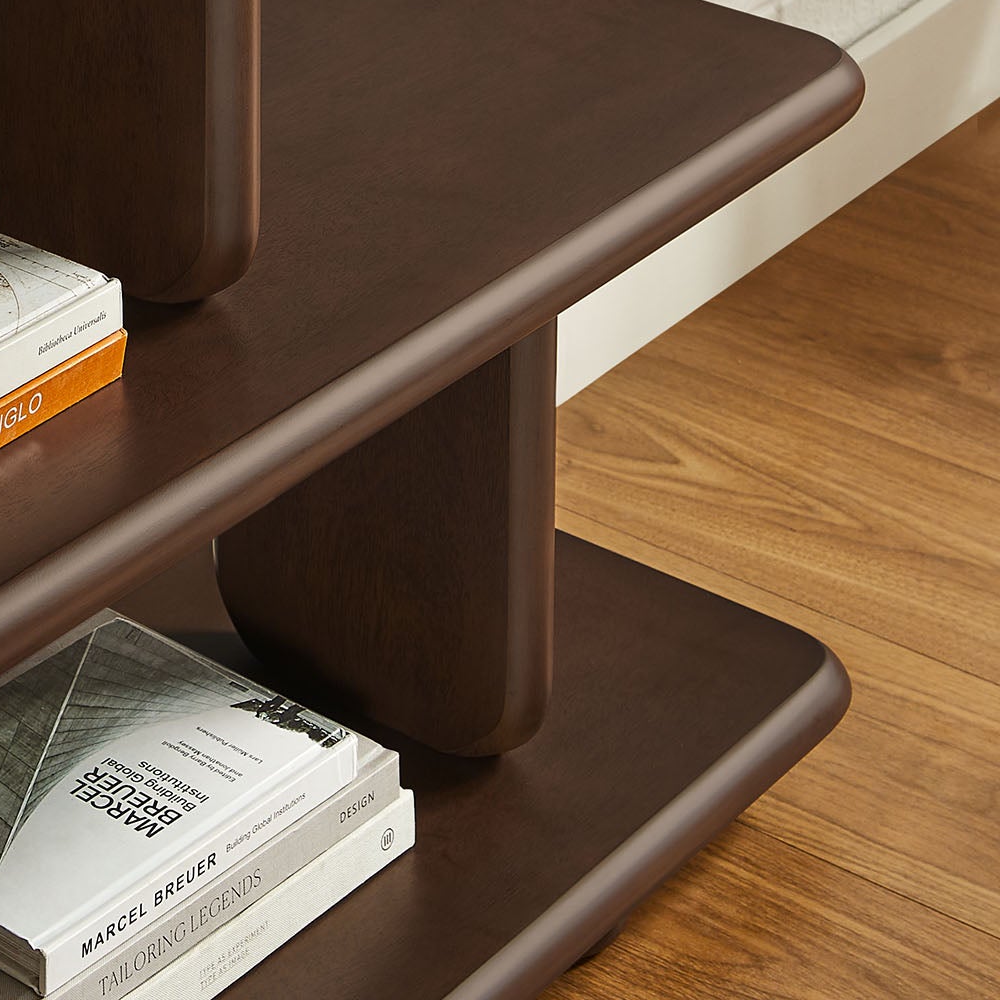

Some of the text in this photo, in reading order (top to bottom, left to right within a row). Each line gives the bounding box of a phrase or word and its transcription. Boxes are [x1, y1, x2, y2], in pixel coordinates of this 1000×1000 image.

[73, 310, 107, 335] Universalis
[138, 761, 210, 804] Institutions
[178, 740, 244, 778] and Jonathan Massey
[189, 755, 208, 768] Barry
[212, 768, 237, 783] Edited
[70, 778, 164, 838] MARCEL
[83, 767, 182, 826] BREUER
[101, 757, 196, 812] Building Global
[339, 790, 377, 824] DESIGN
[226, 792, 307, 854] Building Global Institutions
[81, 852, 217, 958] MARCEL BREUER
[98, 868, 263, 996] TAILORING LEGENDS
